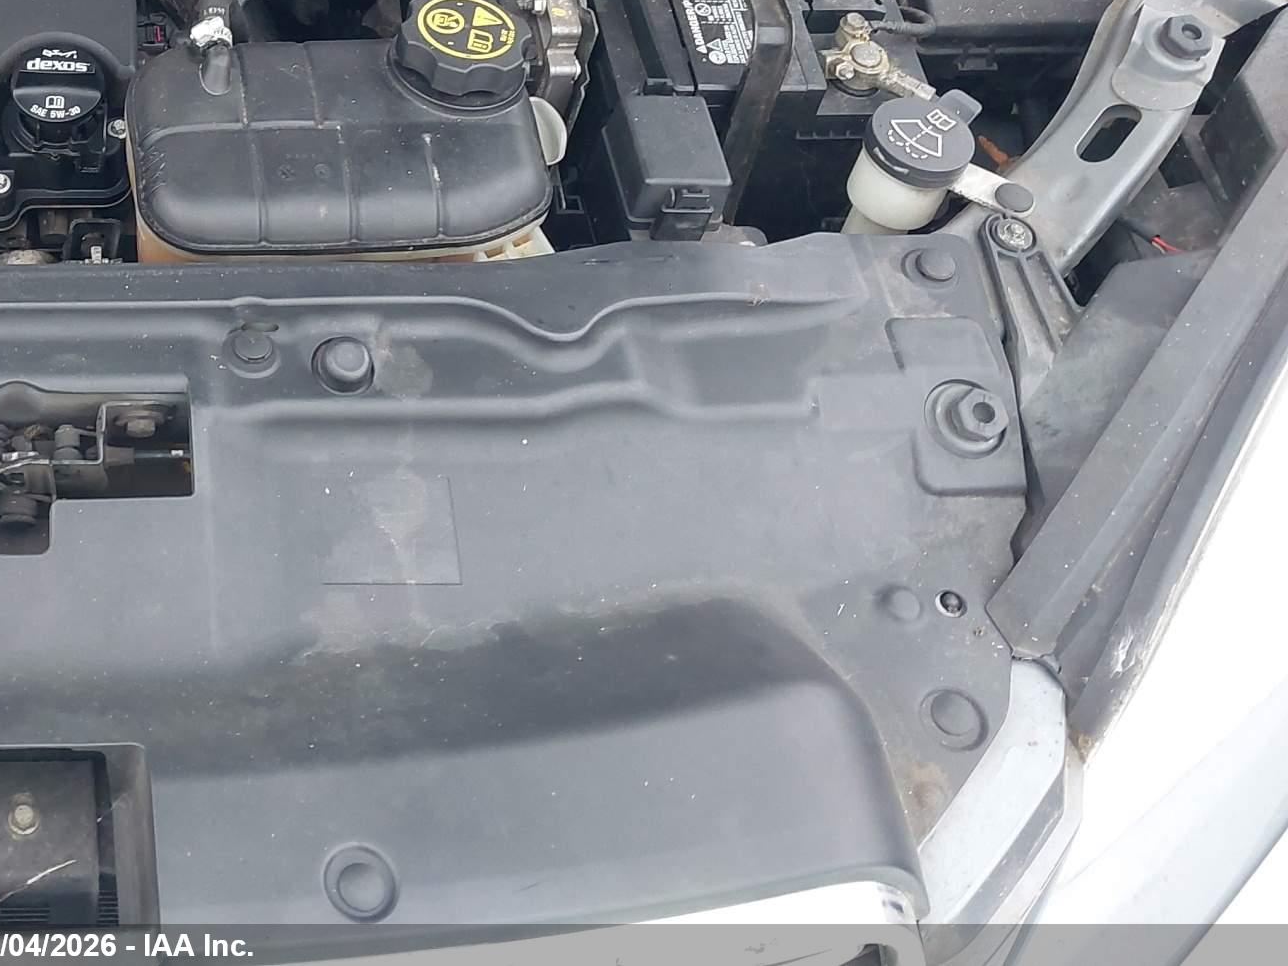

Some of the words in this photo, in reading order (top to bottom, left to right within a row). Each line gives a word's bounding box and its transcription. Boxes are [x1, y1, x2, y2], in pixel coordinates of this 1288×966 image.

[26, 58, 90, 72] dexos
[30, 104, 48, 117] SAE
[50, 106, 81, 118] 5W-30
